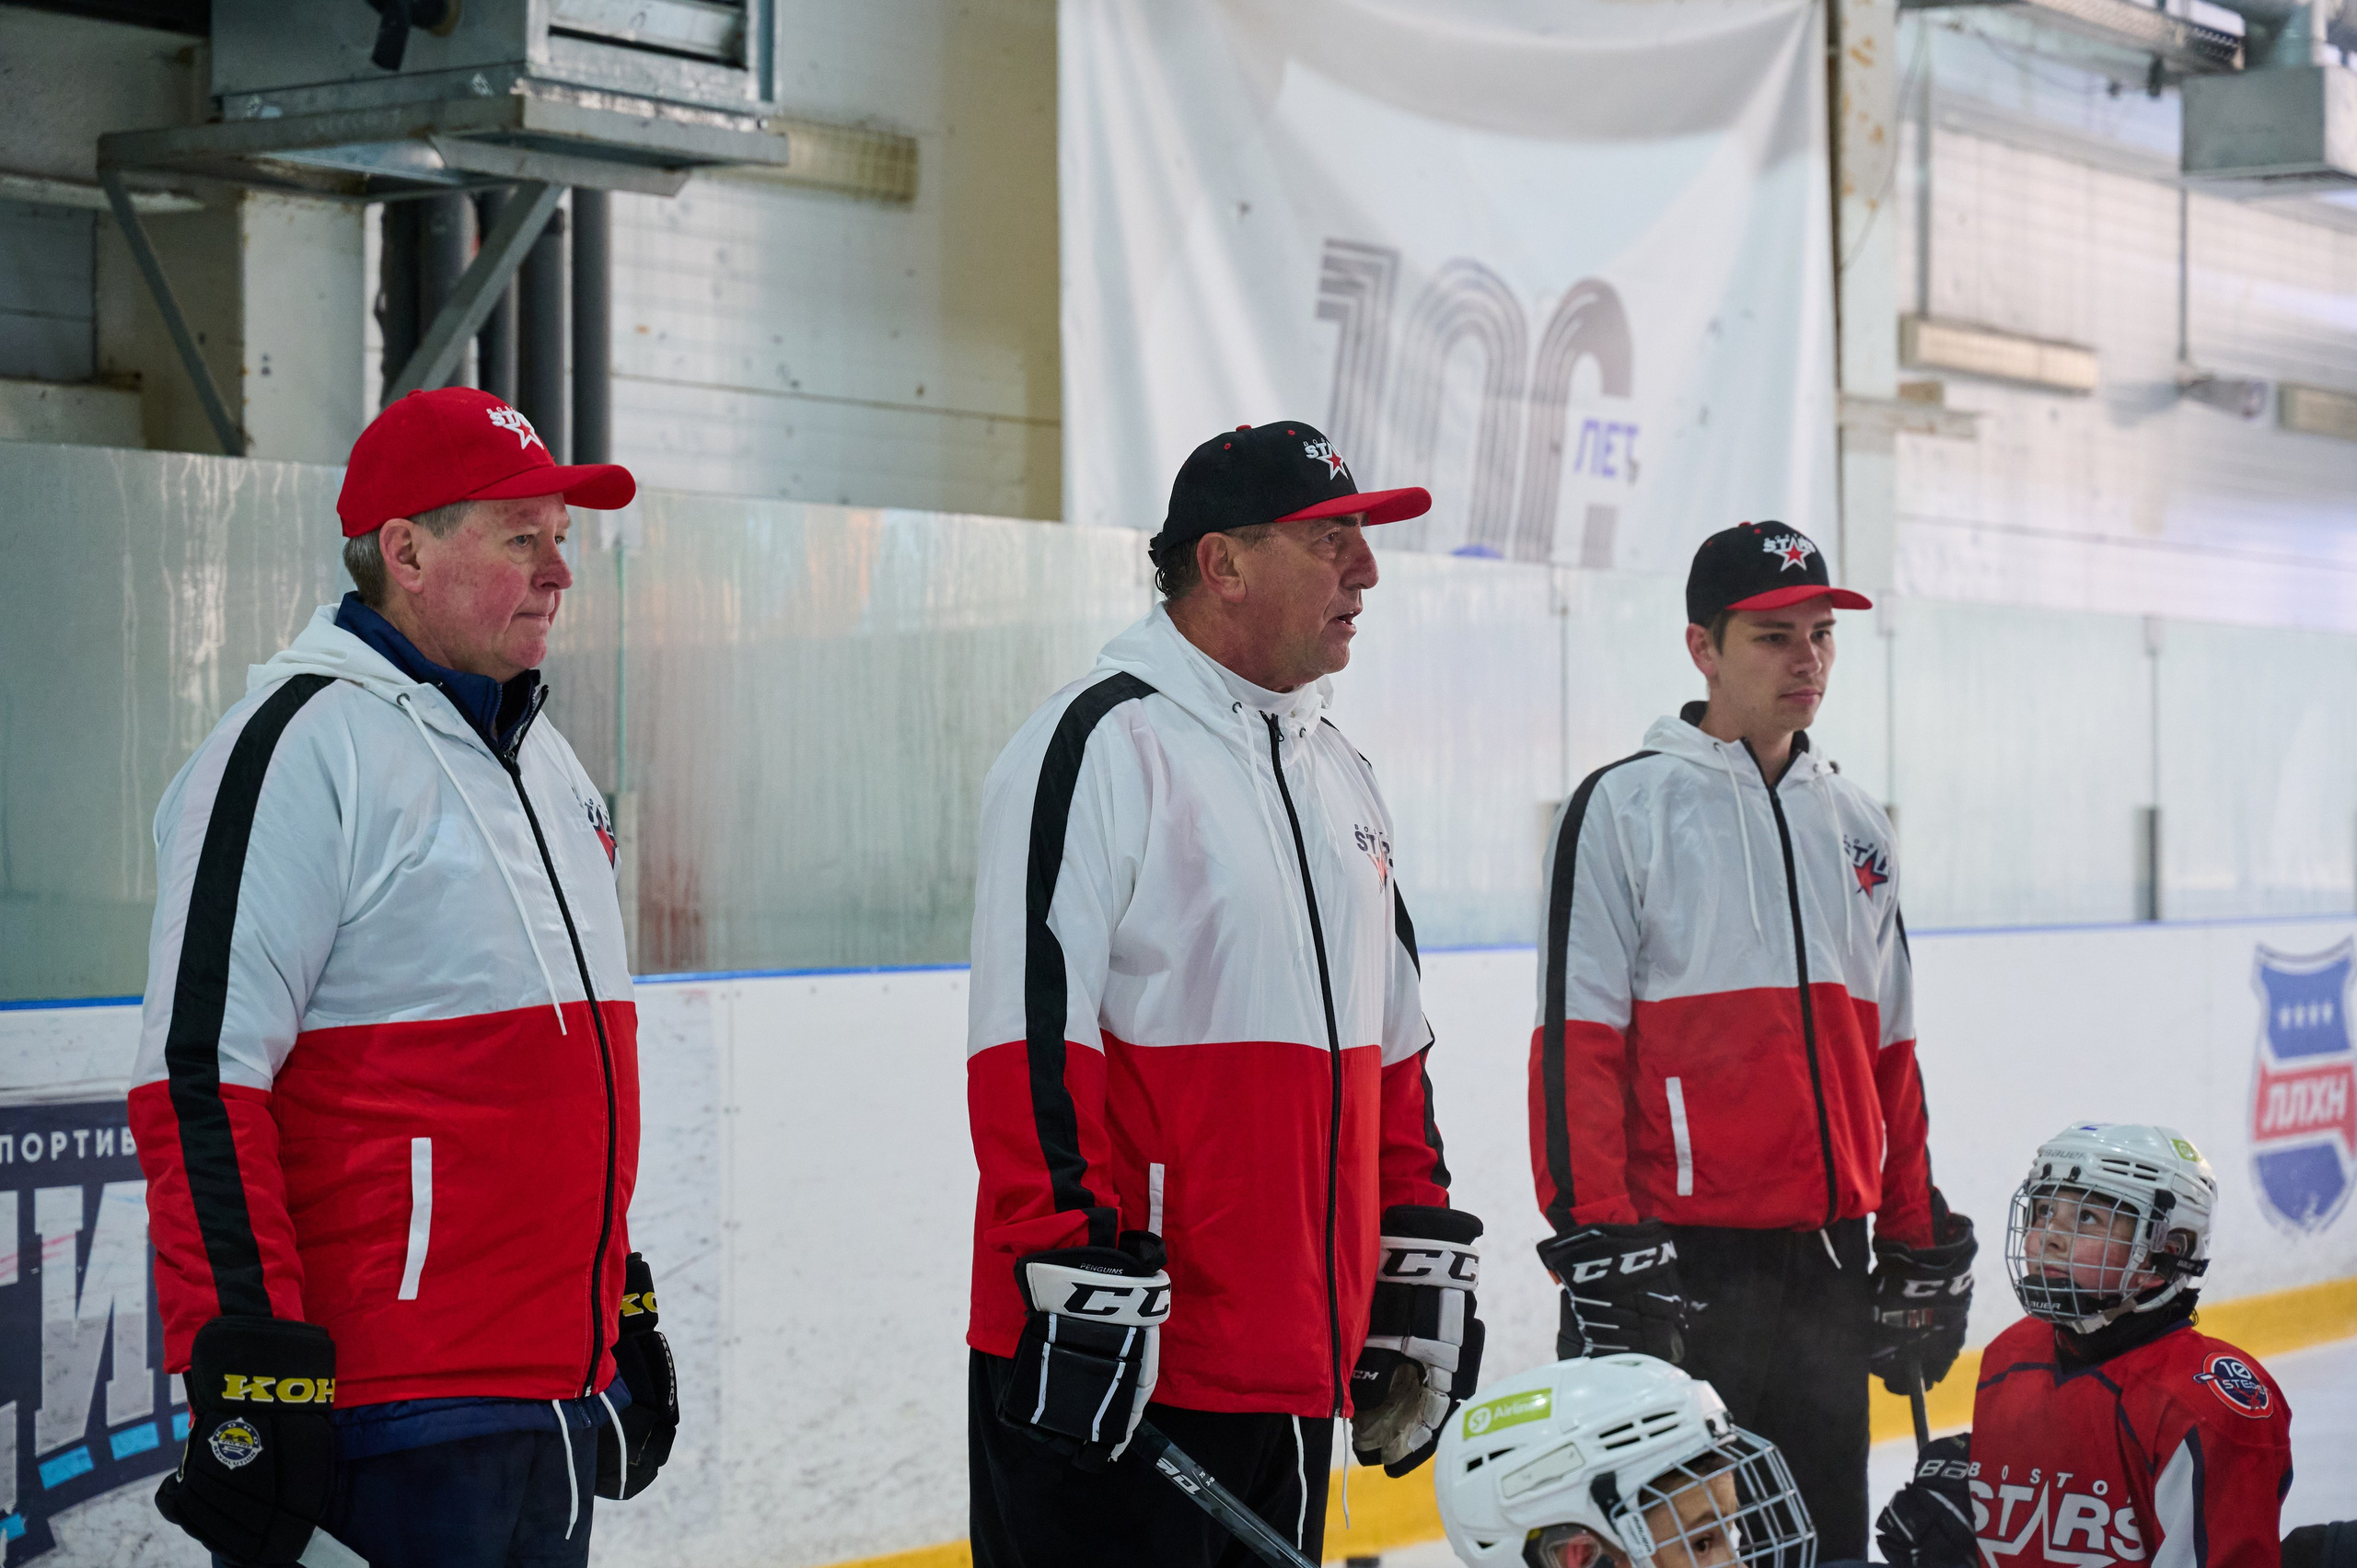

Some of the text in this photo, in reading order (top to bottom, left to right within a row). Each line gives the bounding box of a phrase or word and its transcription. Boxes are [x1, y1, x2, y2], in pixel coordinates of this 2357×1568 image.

[0, 1127, 136, 1164] ПОРТИВ
[1080, 1262, 1124, 1275] PENGUINS
[1382, 1249, 1479, 1282] CC
[1063, 1282, 1171, 1318] CC
[222, 1374, 335, 1404] KOH
[1352, 1369, 1379, 1381] CM
[1968, 1461, 2132, 1504] BOSTO
